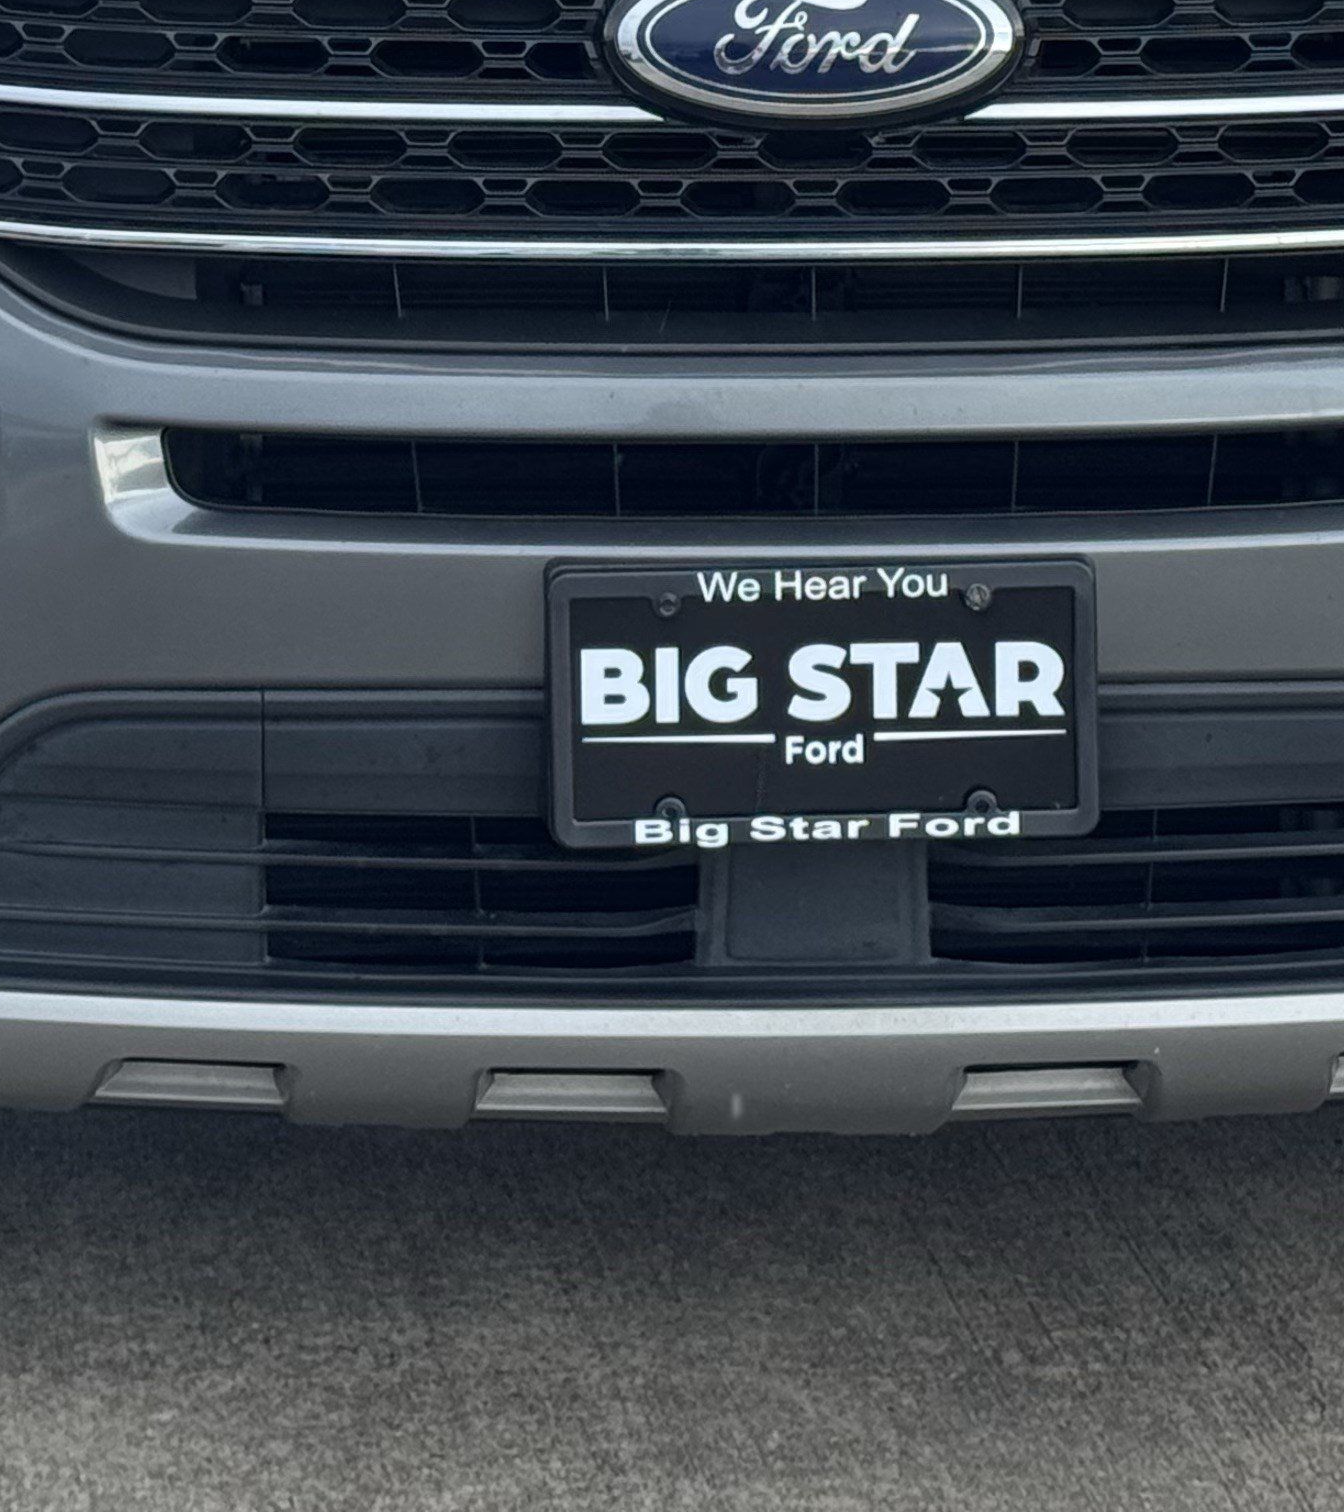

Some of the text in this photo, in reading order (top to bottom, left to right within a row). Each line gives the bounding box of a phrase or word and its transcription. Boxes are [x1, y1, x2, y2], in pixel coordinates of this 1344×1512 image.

[697, 566, 948, 602] We Hear You
[580, 640, 1065, 726] BIG STAR
[785, 733, 864, 765] Ford
[634, 810, 1020, 849] Big Star Ford
